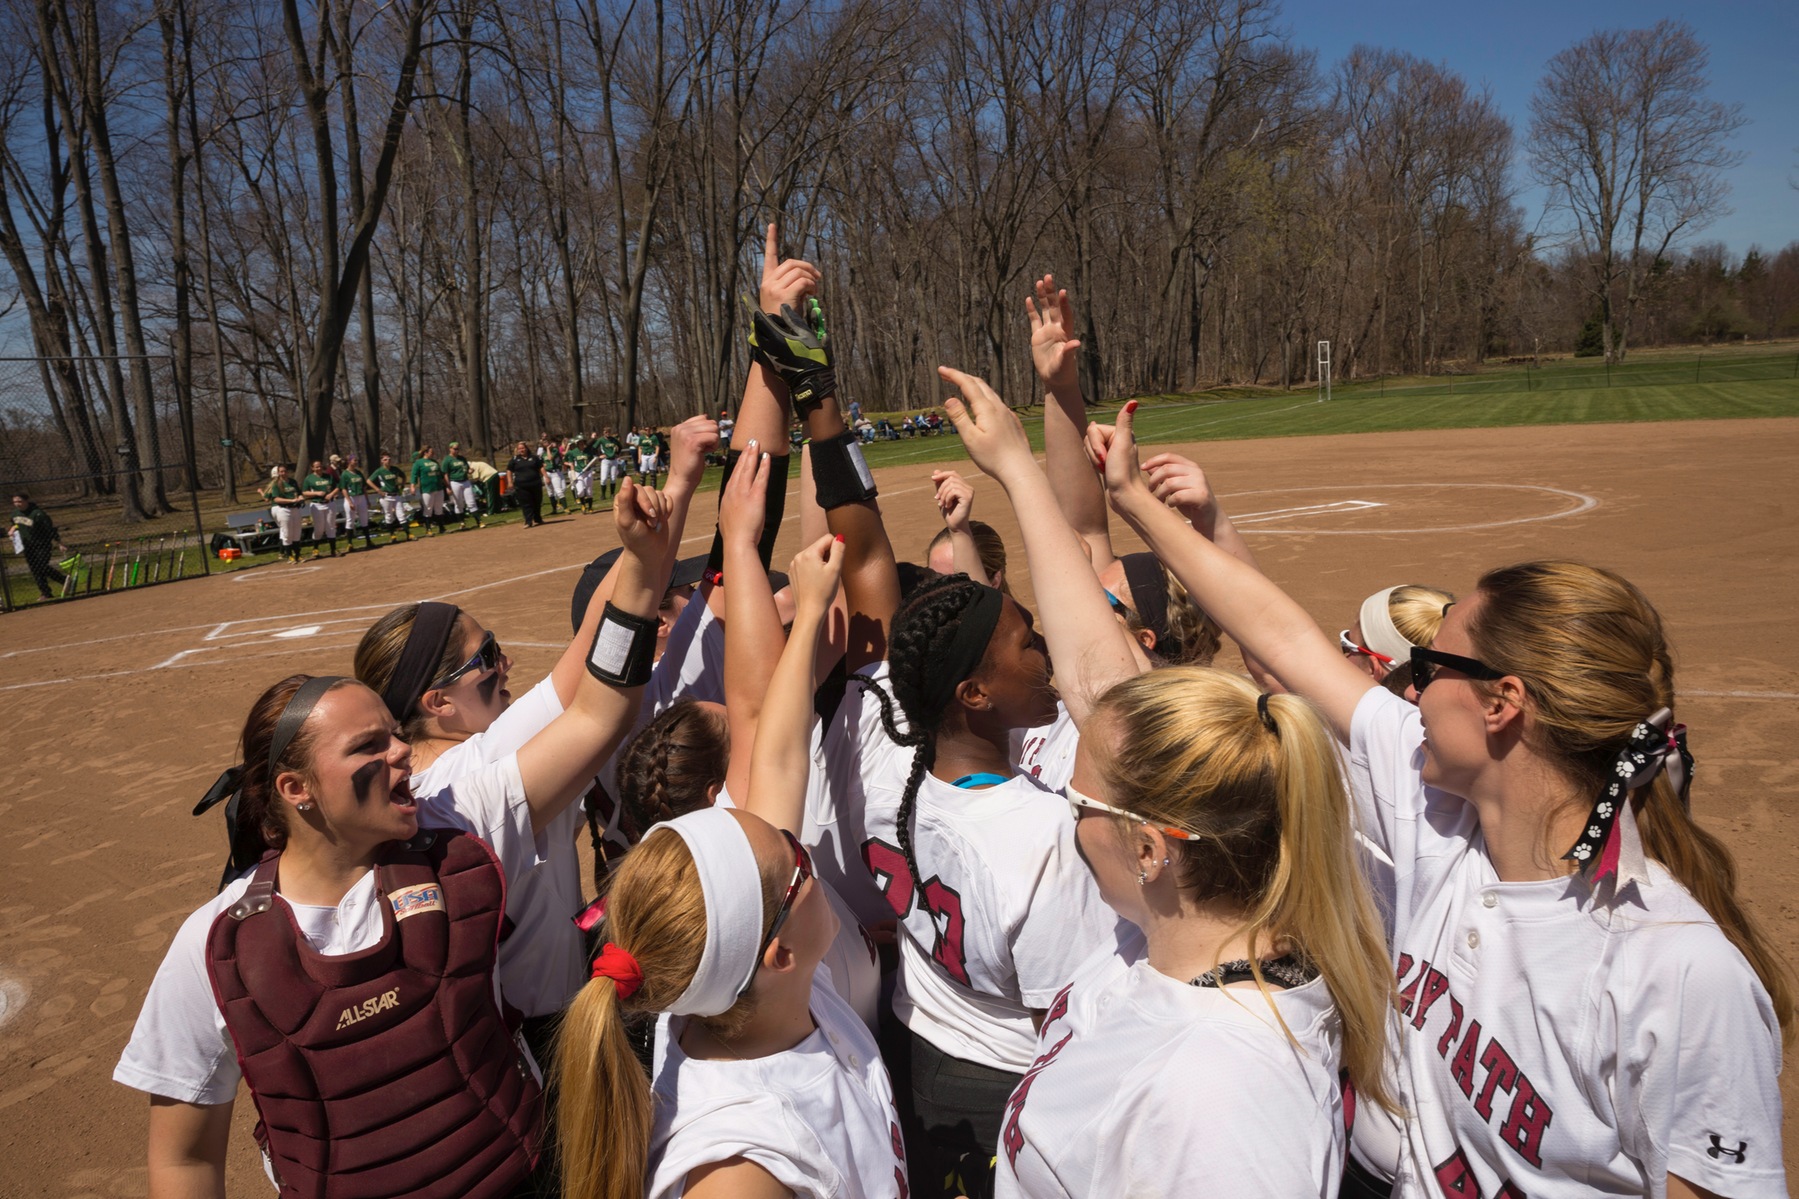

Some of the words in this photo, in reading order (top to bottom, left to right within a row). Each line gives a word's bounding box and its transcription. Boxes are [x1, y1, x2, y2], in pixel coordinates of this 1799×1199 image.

[393, 889, 439, 910] USA
[335, 989, 400, 1031] ALL-STAR
[1437, 993, 1553, 1170] PATH
